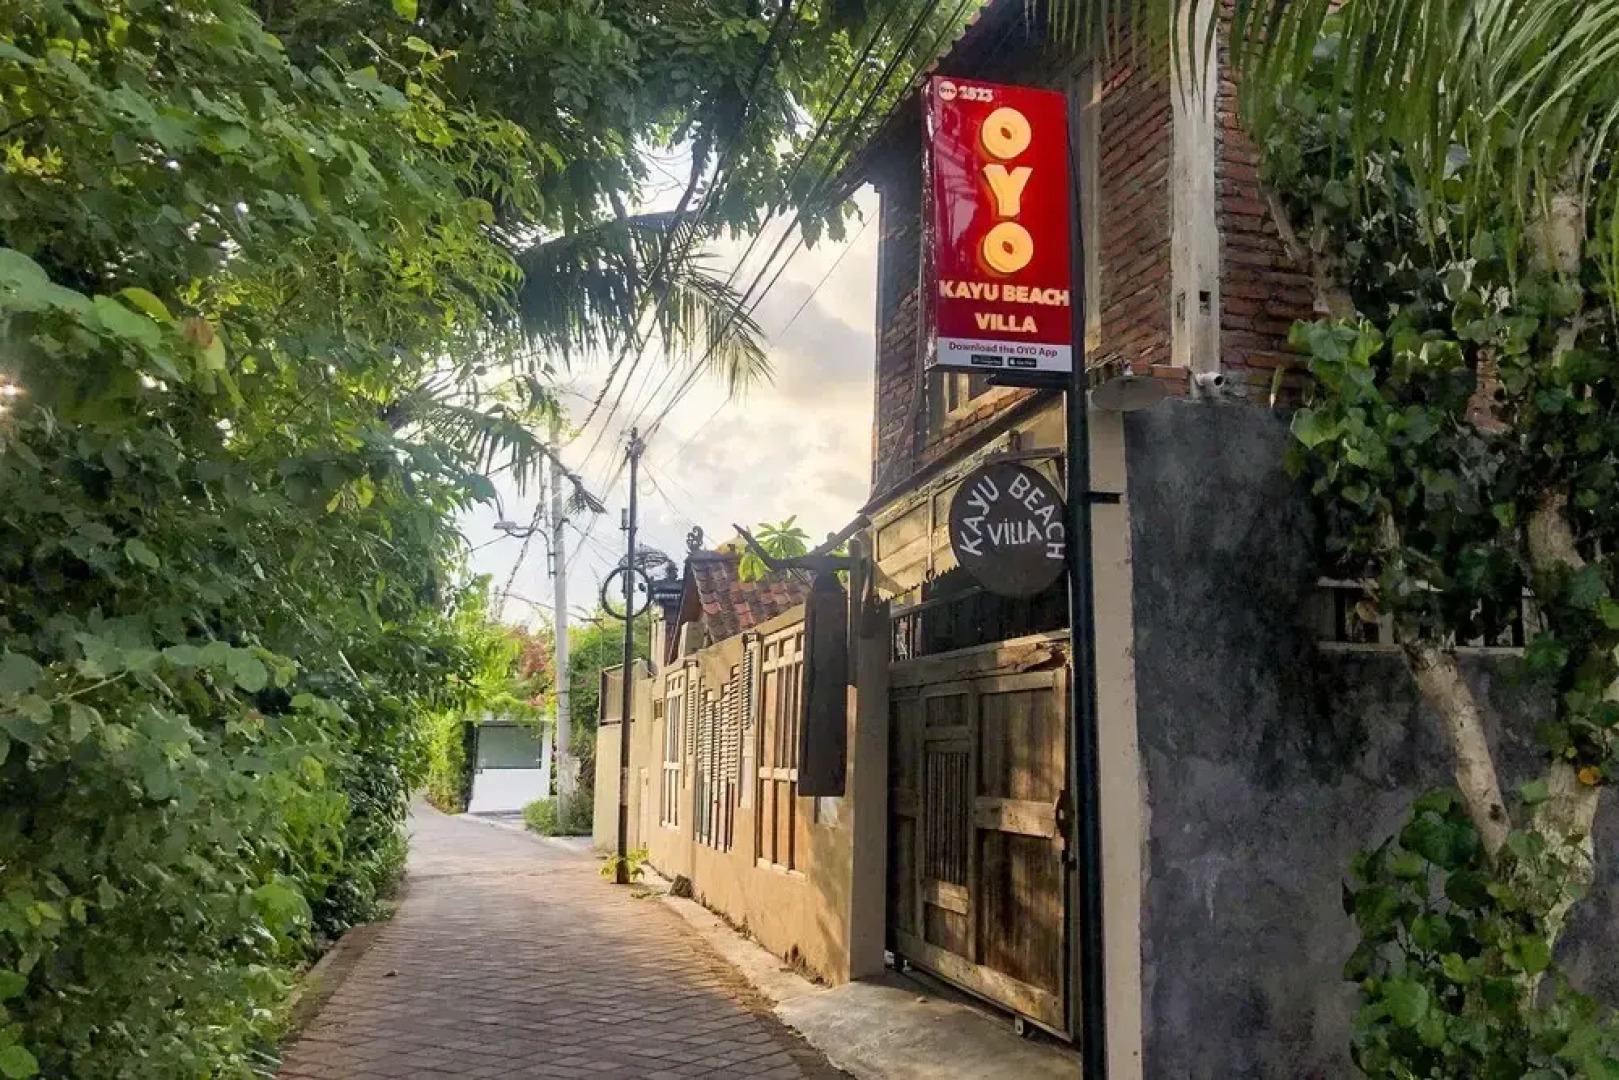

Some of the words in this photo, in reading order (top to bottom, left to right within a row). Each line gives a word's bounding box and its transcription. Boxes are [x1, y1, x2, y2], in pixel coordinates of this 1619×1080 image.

[981, 106, 1034, 274] OYO
[939, 280, 1000, 300] KAYU
[1003, 284, 1069, 306] BEACH
[975, 313, 1038, 333] VILLA
[949, 342, 997, 353] Download
[998, 345, 1014, 354] the
[1016, 346, 1037, 355] OYO
[1039, 347, 1058, 358] App
[959, 475, 1000, 556] KAYU
[1008, 472, 1066, 559] BEACH
